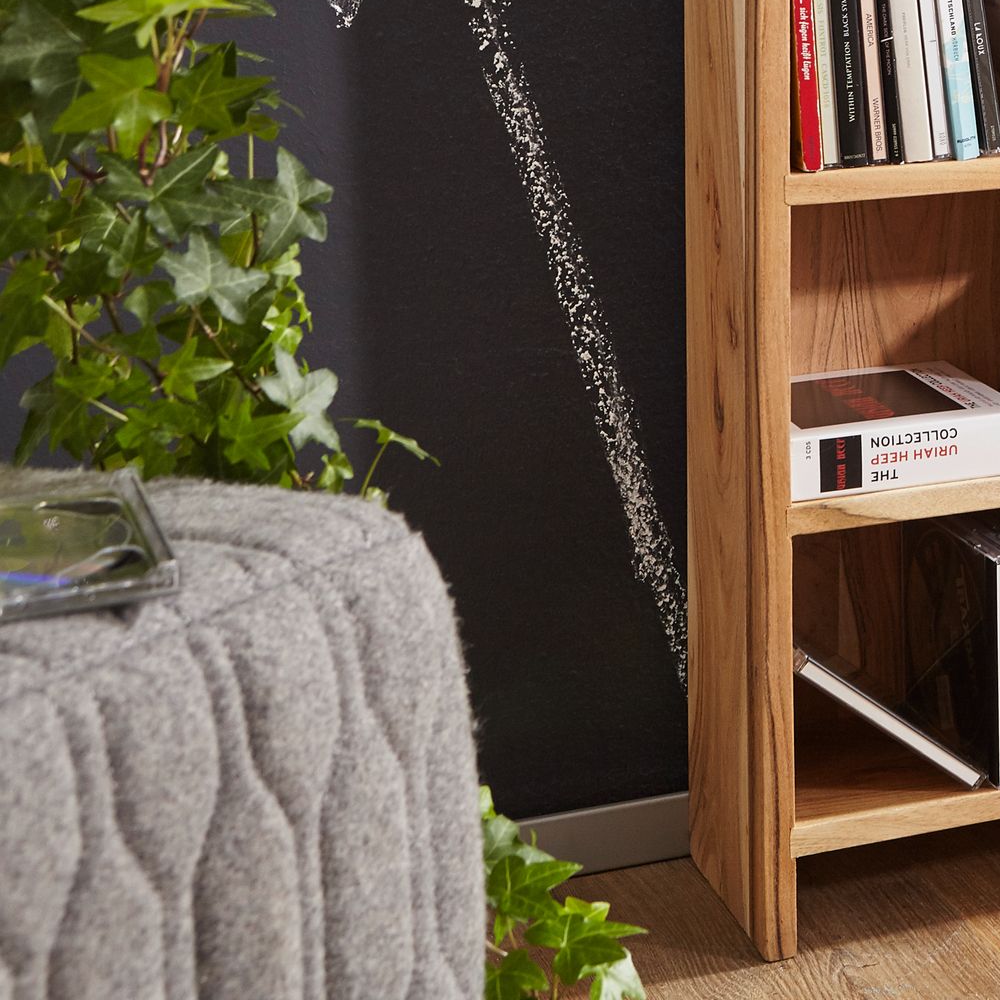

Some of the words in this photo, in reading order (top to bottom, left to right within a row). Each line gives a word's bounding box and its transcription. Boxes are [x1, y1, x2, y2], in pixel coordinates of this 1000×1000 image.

[799, 7, 809, 20] sich
[798, 21, 810, 41] fügen
[841, 13, 850, 37] BLACK
[843, 41, 854, 90] TEMPTATION
[865, 13, 874, 47] AMERICA
[872, 97, 881, 131] WARNER
[847, 91, 856, 123] WITHIN
[870, 428, 958, 449] COLLECTION
[870, 451, 908, 465] HEEP
[913, 445, 958, 460] URIAH
[870, 469, 899, 482] THE
